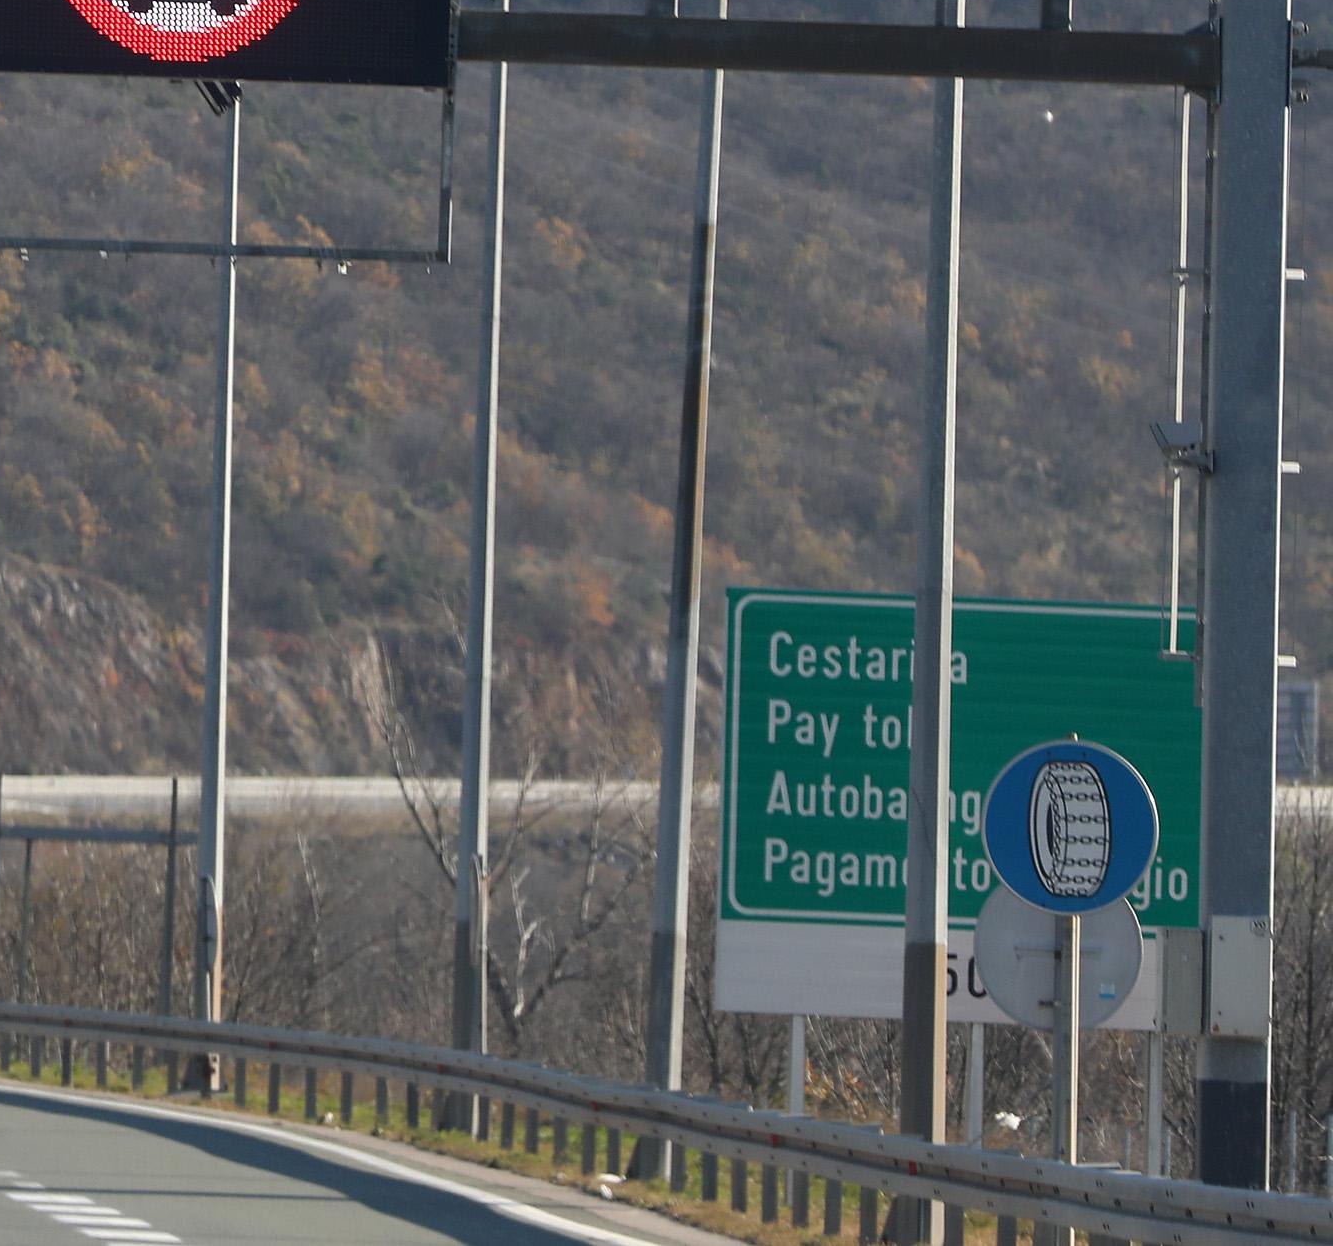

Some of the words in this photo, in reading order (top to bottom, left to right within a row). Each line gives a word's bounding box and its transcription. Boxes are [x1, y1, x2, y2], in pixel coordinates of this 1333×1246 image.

[770, 630, 967, 685] Cestaria
[767, 698, 840, 758] Pay
[863, 703, 913, 750] tol
[764, 837, 991, 898] Pagamto
